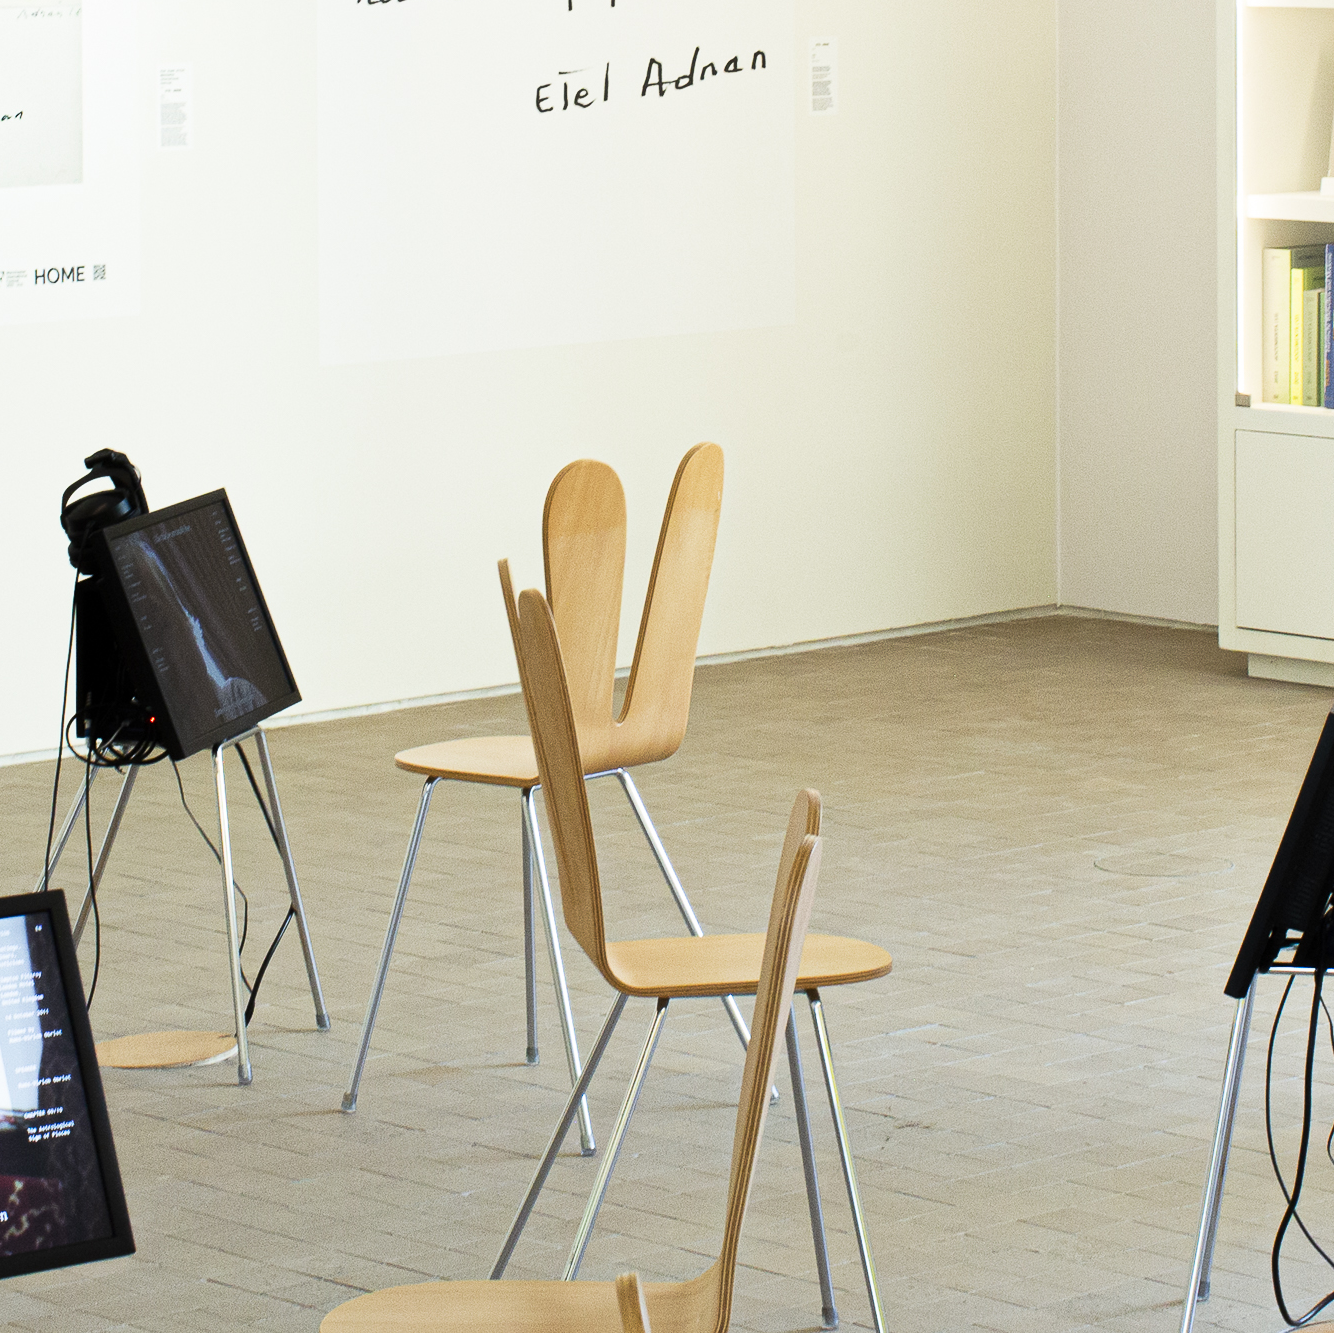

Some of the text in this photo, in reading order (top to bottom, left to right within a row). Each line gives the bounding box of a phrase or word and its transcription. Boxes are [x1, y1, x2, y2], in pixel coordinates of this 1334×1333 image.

[535, 62, 610, 114] Etel
[640, 46, 767, 97] Adnan
[34, 265, 85, 285] HOME
